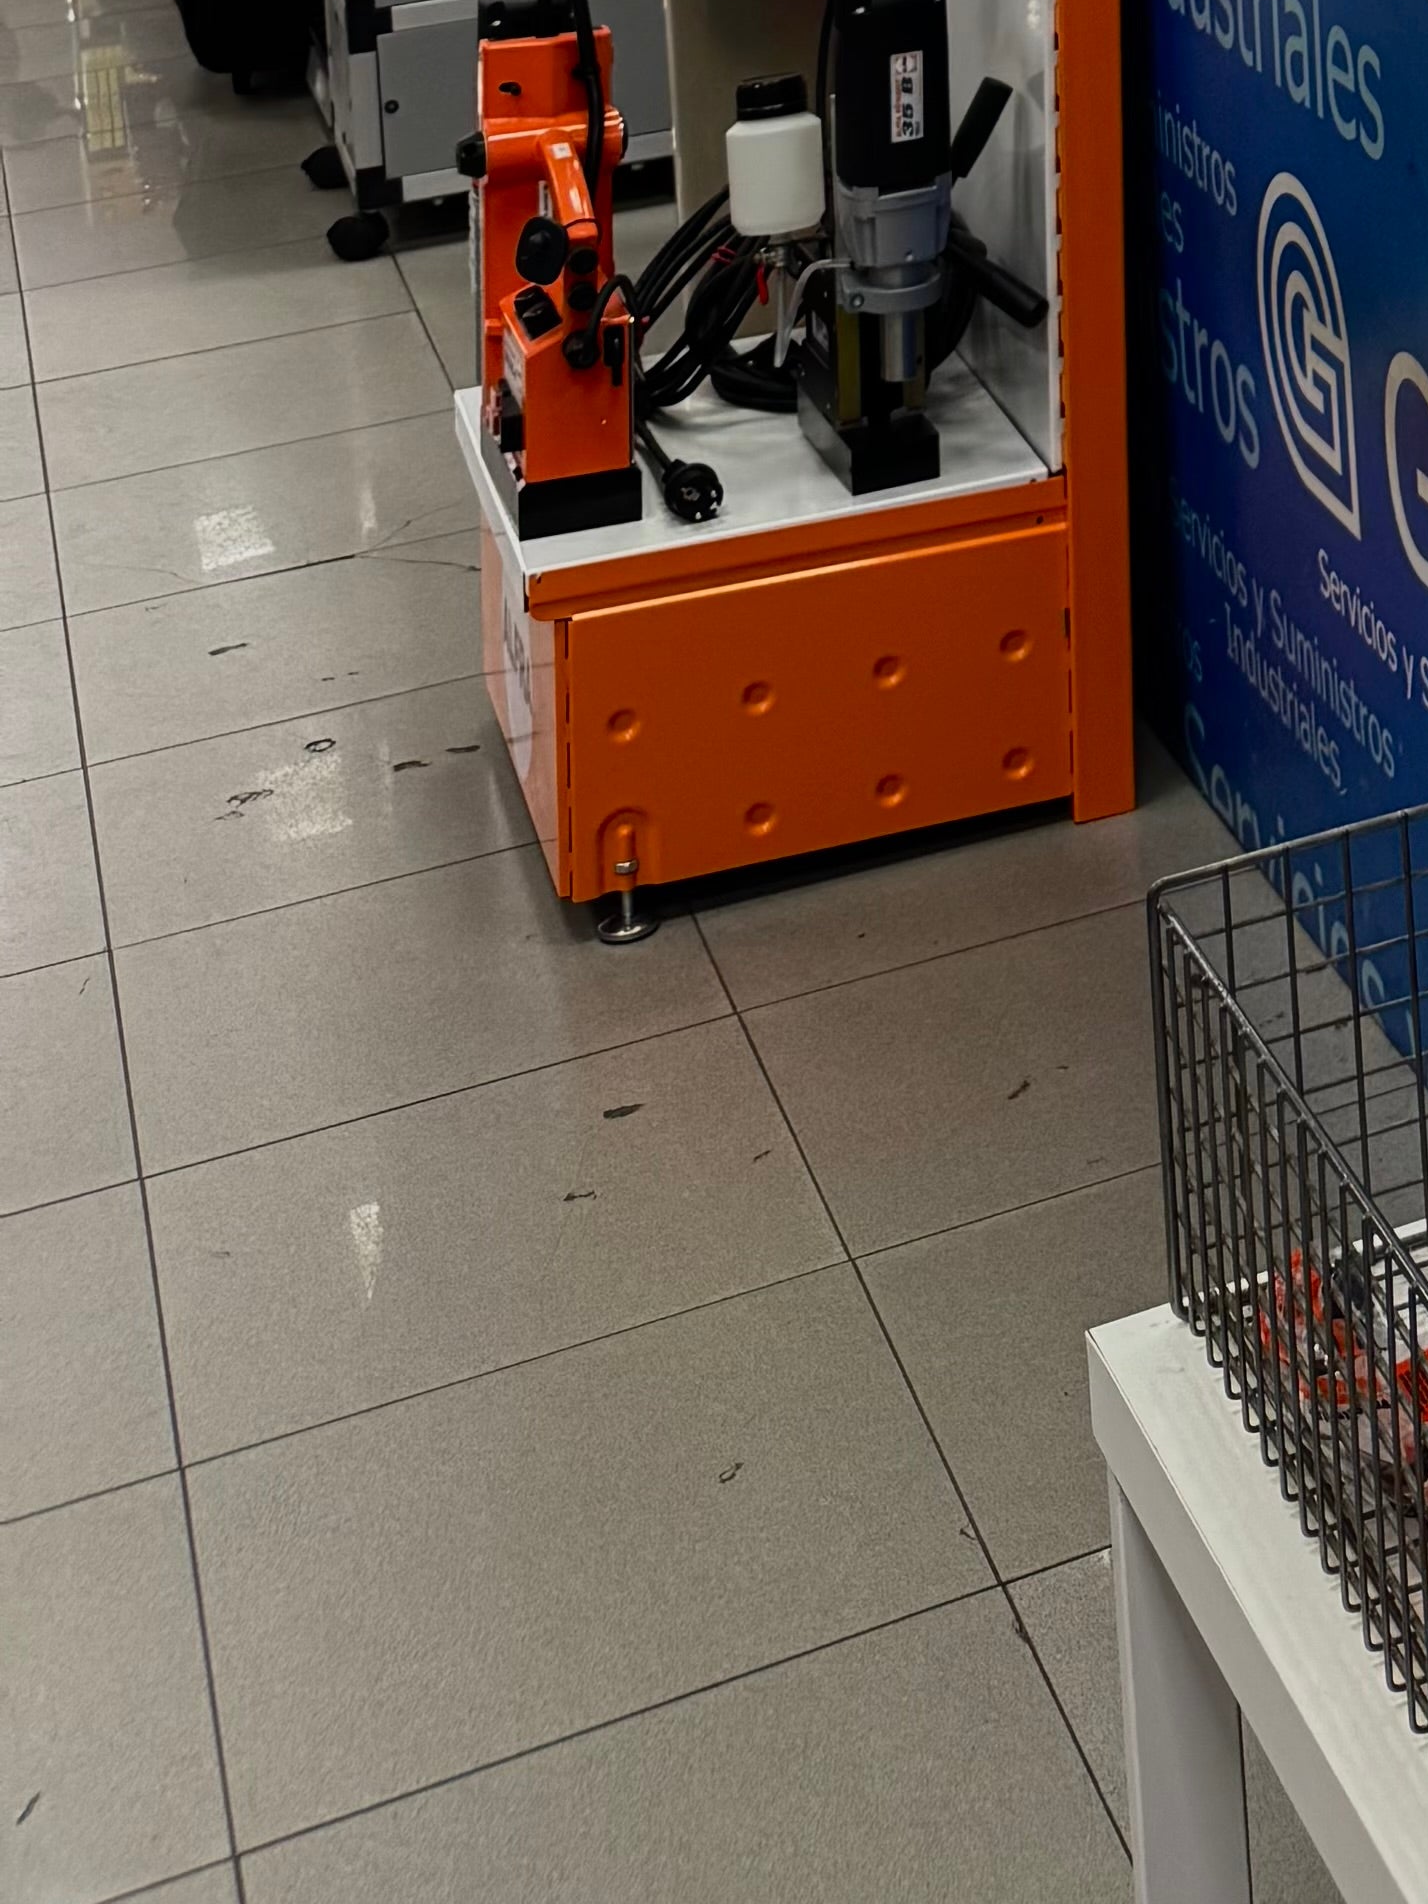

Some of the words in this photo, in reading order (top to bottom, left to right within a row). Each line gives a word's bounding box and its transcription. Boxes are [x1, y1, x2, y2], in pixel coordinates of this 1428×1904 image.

[1180, 507, 1249, 604] ervicios
[1270, 585, 1396, 780] Suministros
[1225, 600, 1343, 794] Industriales
[1317, 547, 1399, 672] Servicios
[1402, 643, 1414, 700] y
